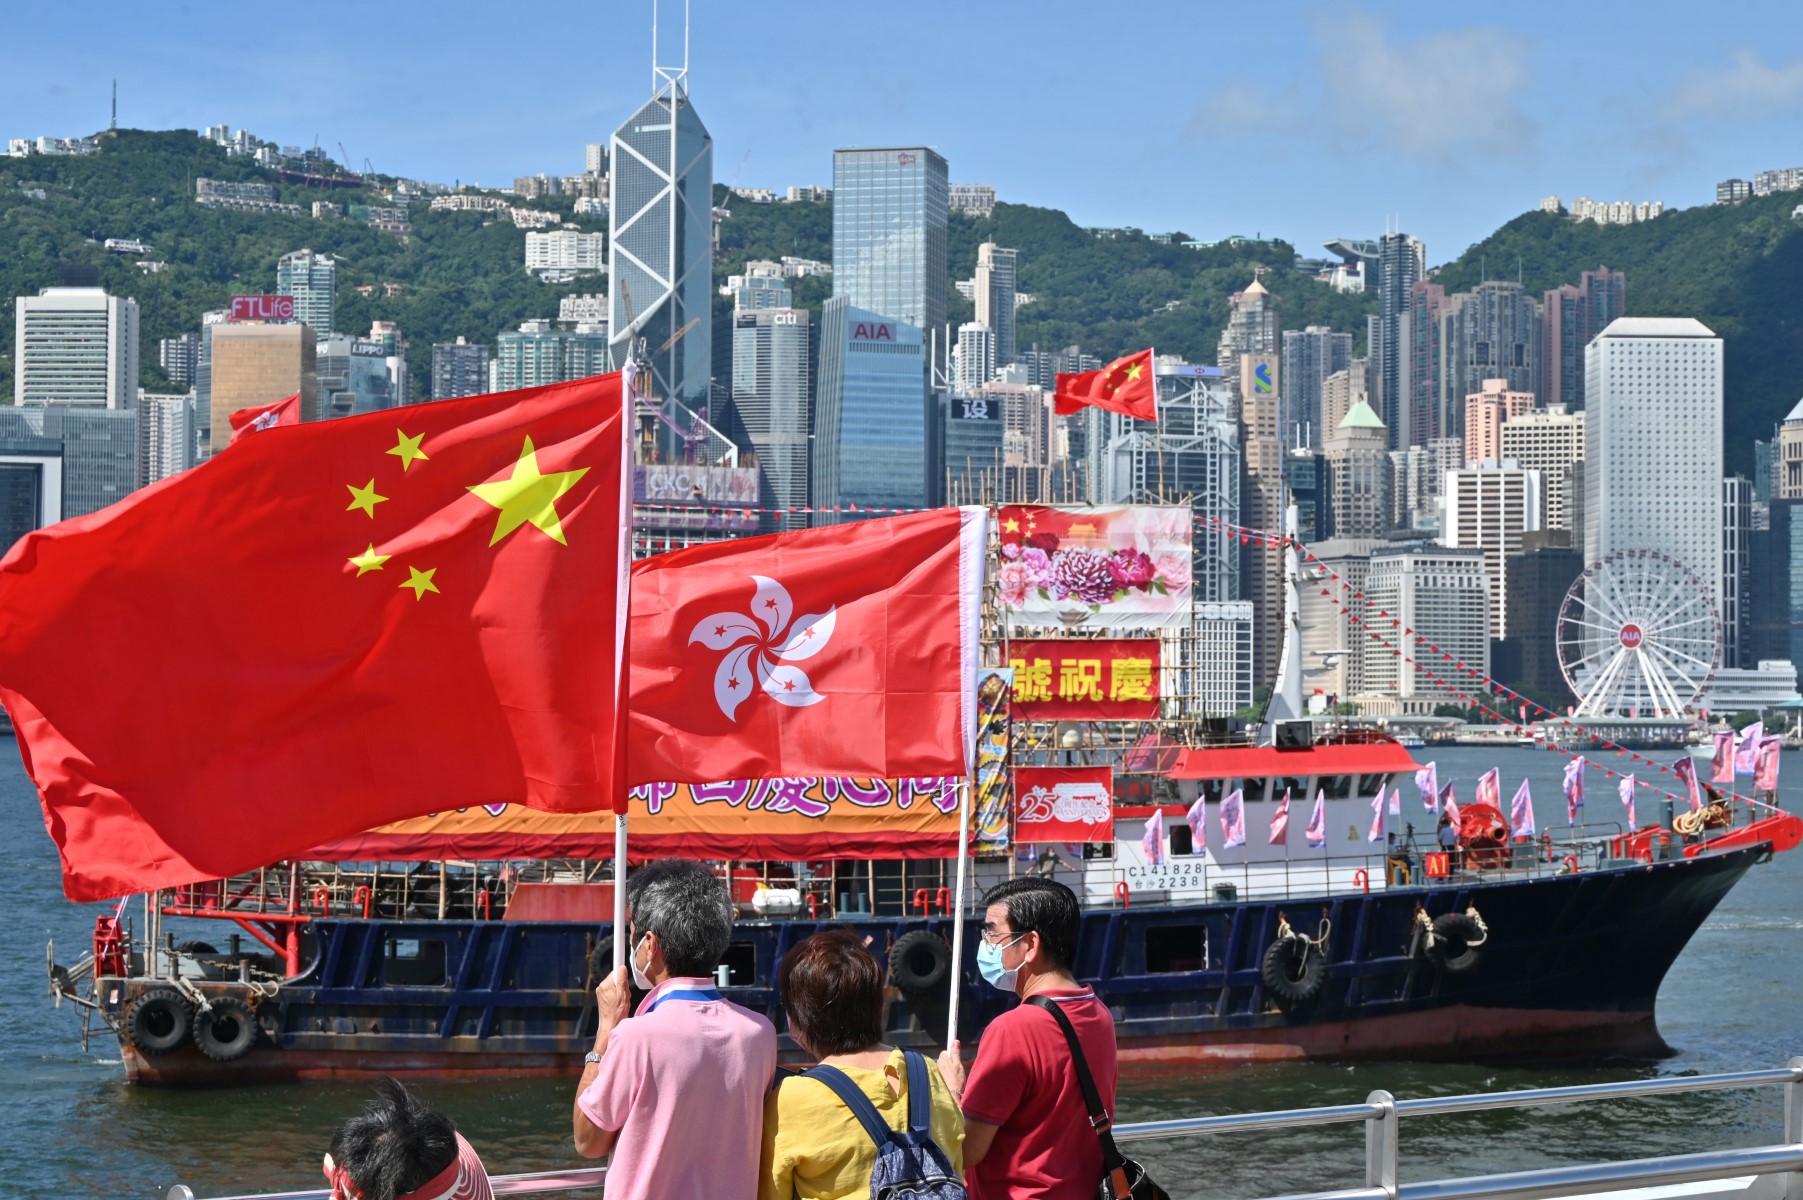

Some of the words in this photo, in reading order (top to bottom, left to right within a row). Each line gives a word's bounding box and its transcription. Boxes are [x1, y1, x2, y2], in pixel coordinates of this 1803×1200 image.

[231, 297, 293, 317] FTLife
[774, 312, 797, 325] citi
[854, 324, 891, 339] AIA
[352, 344, 384, 355] LIPPO
[1622, 631, 1641, 641] AIA
[1017, 792, 1058, 823] 25
[1429, 855, 1447, 875] A1
